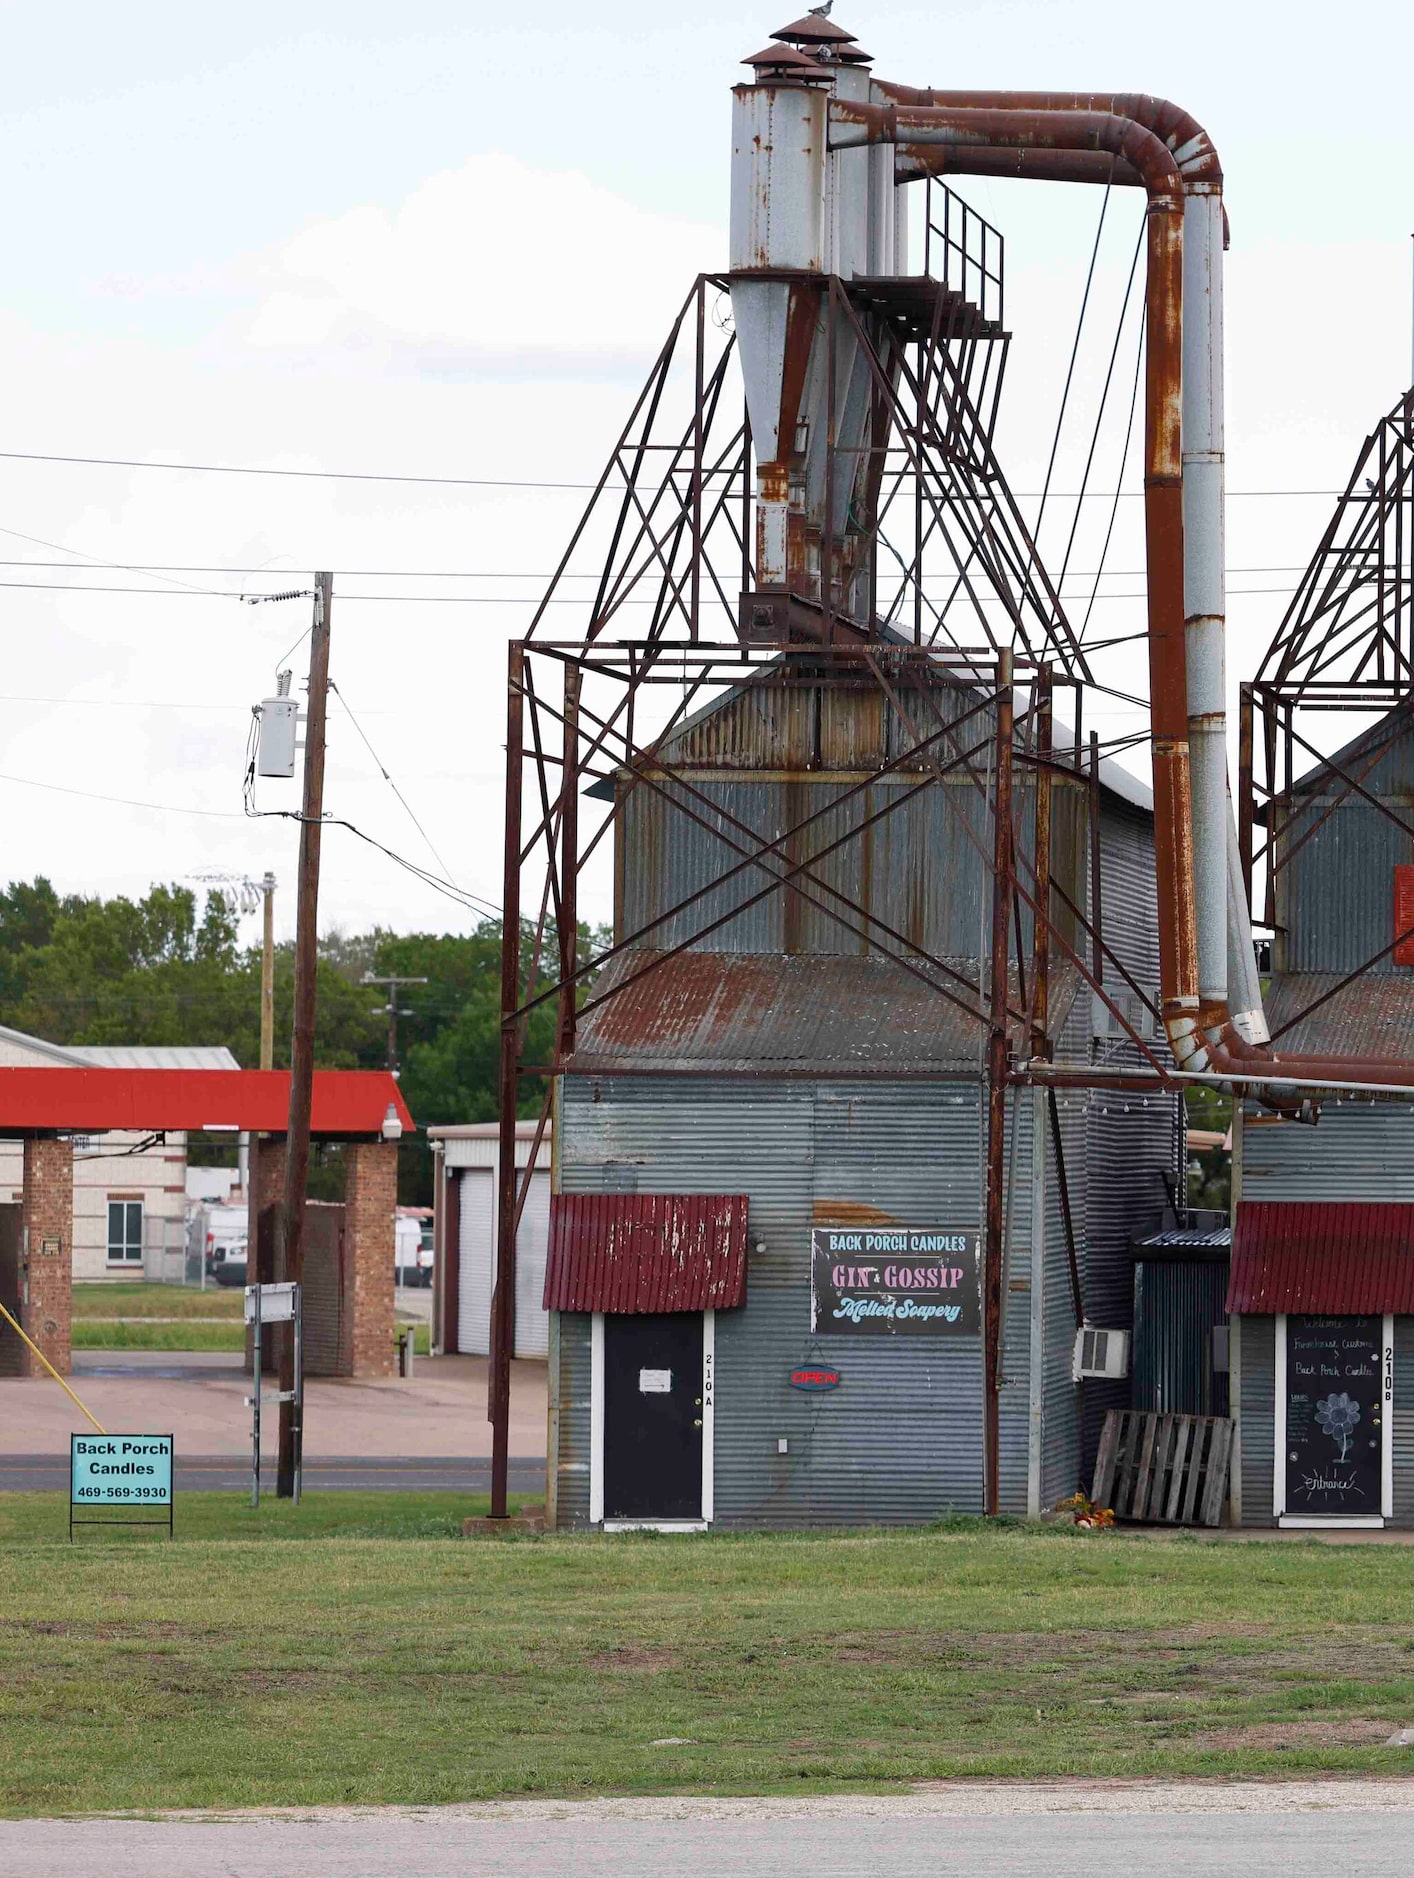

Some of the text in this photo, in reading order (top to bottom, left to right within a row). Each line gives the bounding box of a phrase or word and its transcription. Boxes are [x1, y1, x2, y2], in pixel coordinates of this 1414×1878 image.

[829, 1235, 966, 1251] BACK PORCH CANDLES
[832, 1265, 964, 1289] GIN & GOSSIP
[832, 1297, 961, 1324] Melted Soapery
[1295, 1361, 1316, 1375] Back
[1320, 1363, 1340, 1376] Porch
[791, 1371, 838, 1384] OPEN
[77, 1442, 169, 1455] Back Porch
[89, 1462, 155, 1475] Candles
[78, 1487, 167, 1498] 469-569-3930
